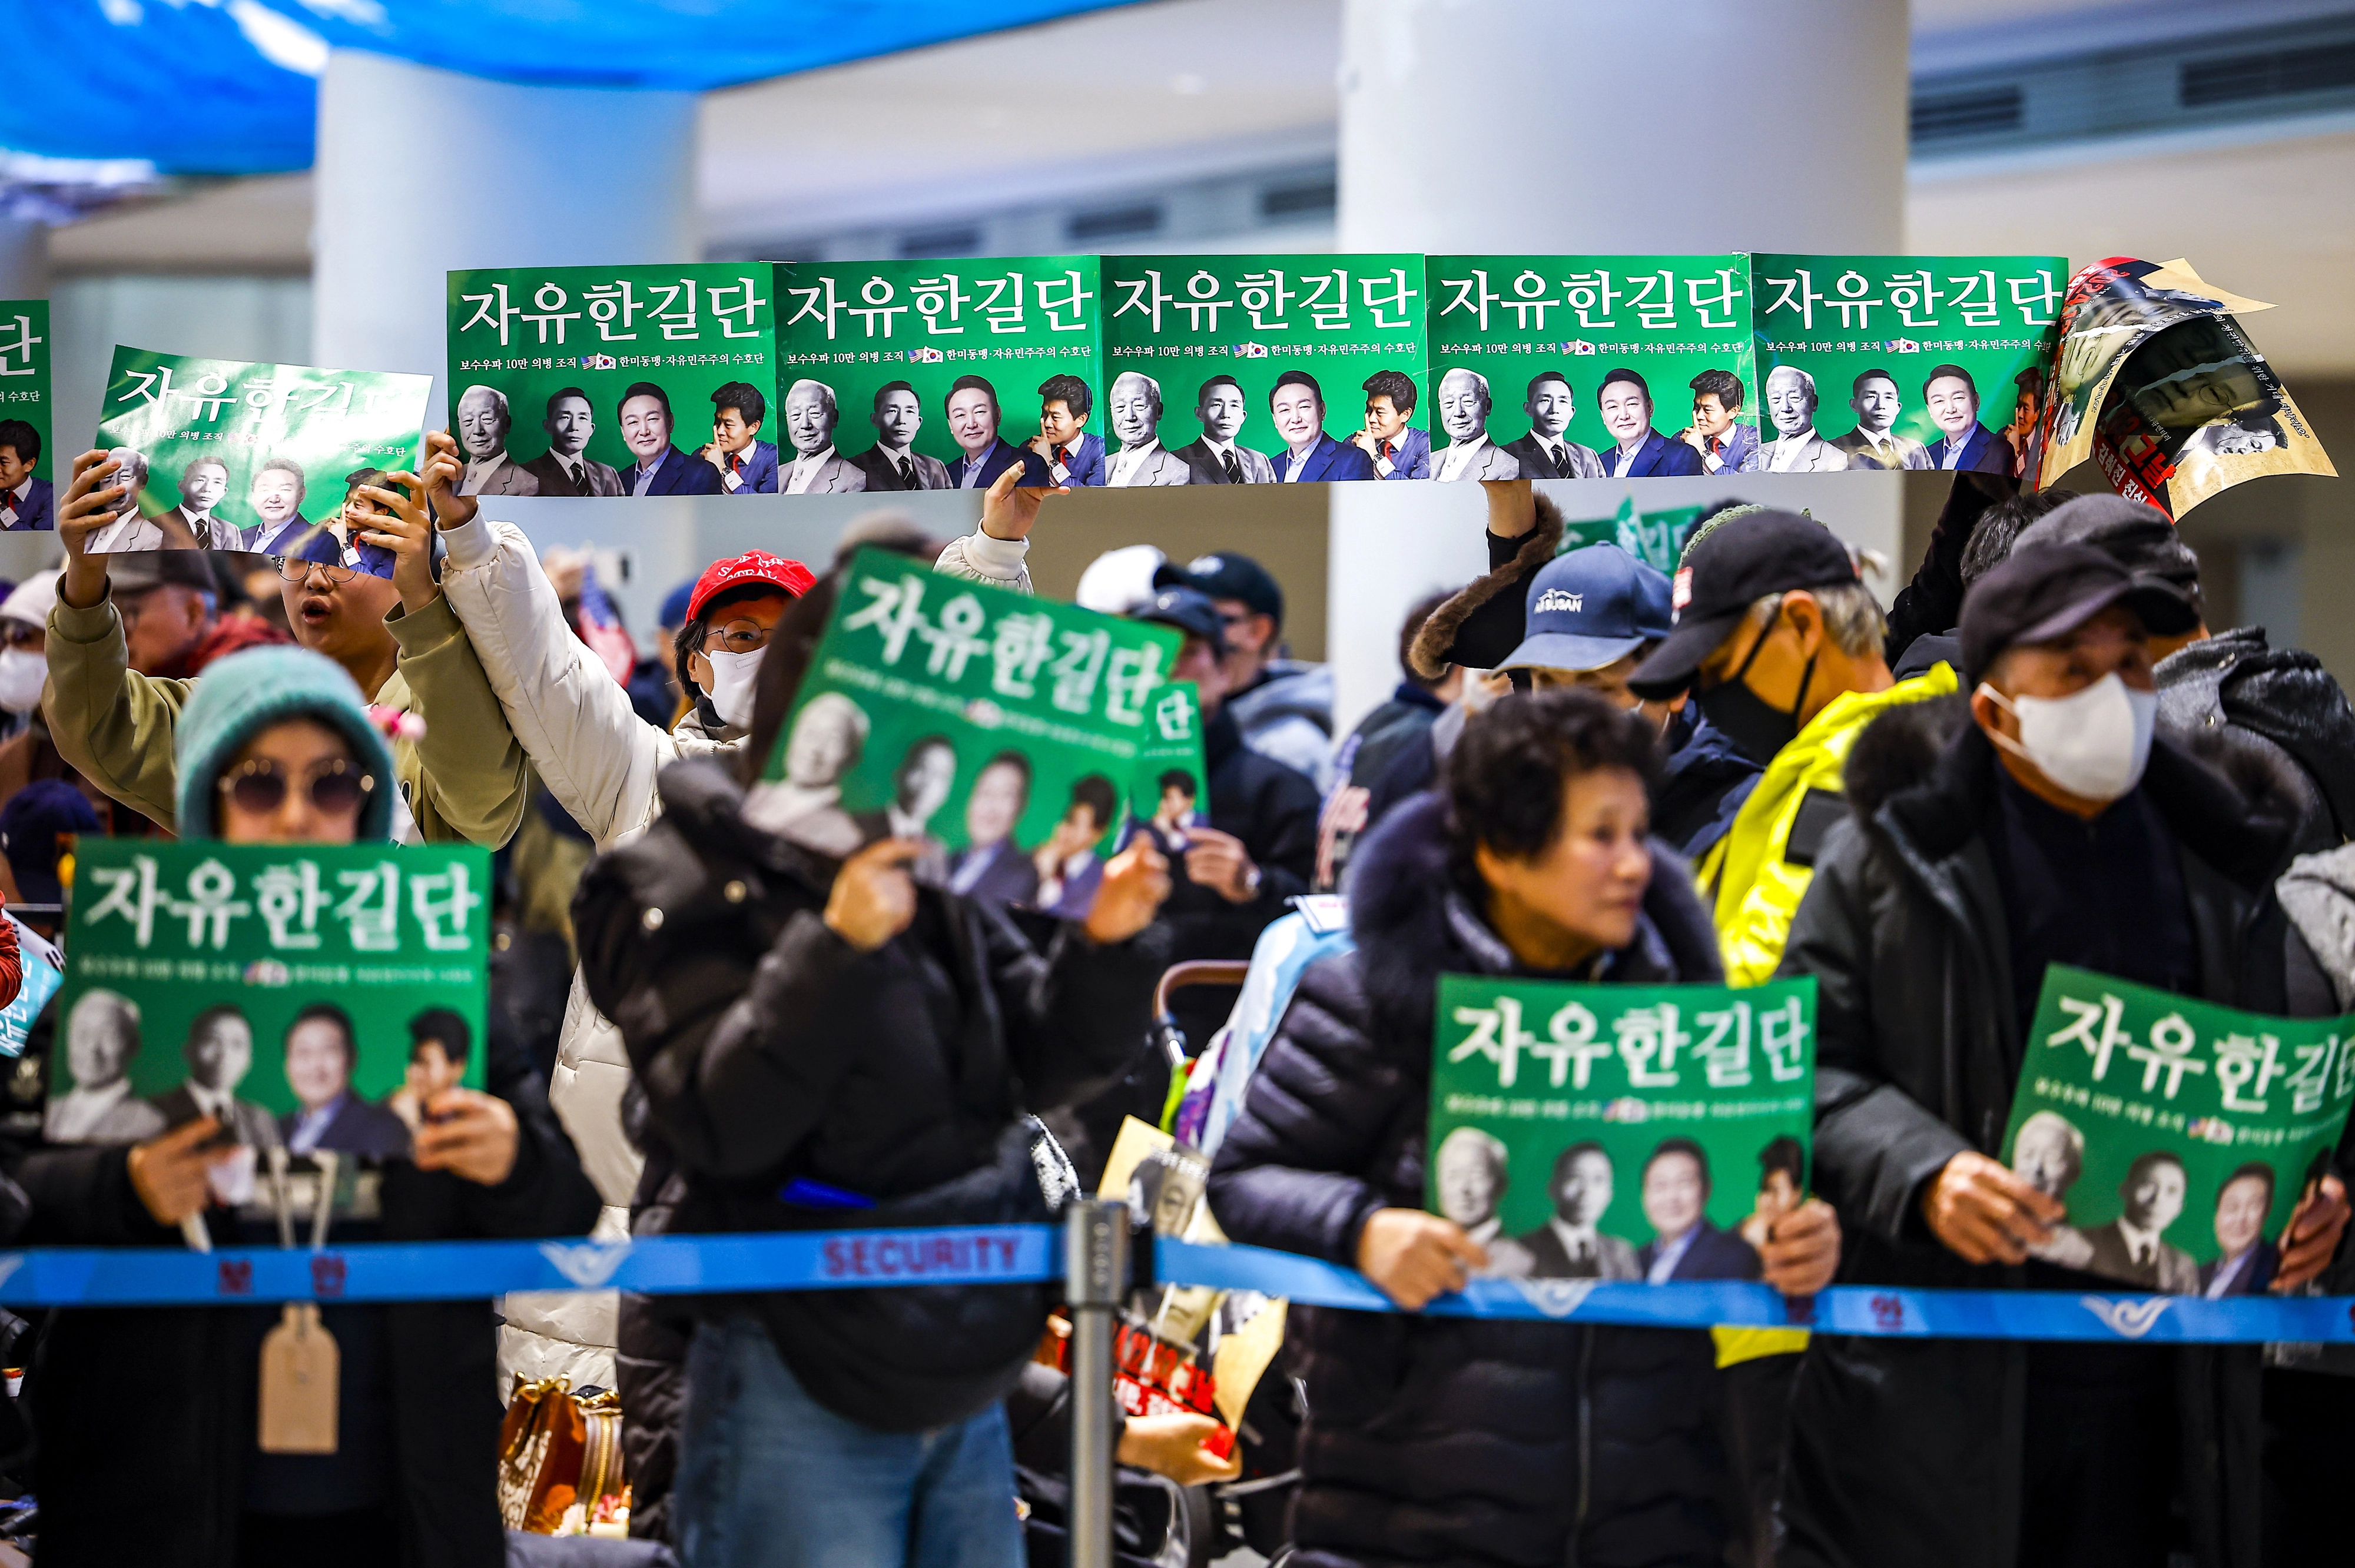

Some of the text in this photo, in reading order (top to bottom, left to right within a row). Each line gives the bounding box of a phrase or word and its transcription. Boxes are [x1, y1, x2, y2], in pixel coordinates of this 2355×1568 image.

[787, 270, 1093, 340] 자유한길단
[1113, 268, 1418, 333] 자유한길단
[1439, 269, 1744, 331] 자유한길단
[1764, 269, 2064, 330] 자유한길단
[460, 277, 766, 346] 자유한길단
[1059, 346, 1092, 358] 수호단
[1112, 345, 1228, 357] 보수우파 10만 의병 조직
[1384, 342, 1416, 354] 수호단
[1440, 343, 1556, 354] 보수우파 10만 의병 조직
[1710, 342, 1742, 354] 수호단
[1766, 341, 1880, 353] 보수우파 10만 의병 조직
[460, 357, 576, 371] 보수우파 10만 의병 조직
[732, 353, 765, 364] 수호단
[787, 350, 903, 365] 보수우파 10만 의병 조직
[2221, 323, 2257, 364] 정권탈취를
[2251, 364, 2270, 382] 위한
[2265, 383, 2284, 400] 거대
[8, 391, 41, 402] 수호단
[180, 430, 201, 443] 의병
[202, 431, 224, 443] 조직
[374, 445, 406, 457] 수호단
[2123, 432, 2178, 490] 그날
[842, 572, 1165, 725] 자유한길단
[83, 853, 483, 952] 자유한길단
[1447, 995, 1810, 1089] 자유한길단
[822, 1234, 1022, 1277] SECURITY
